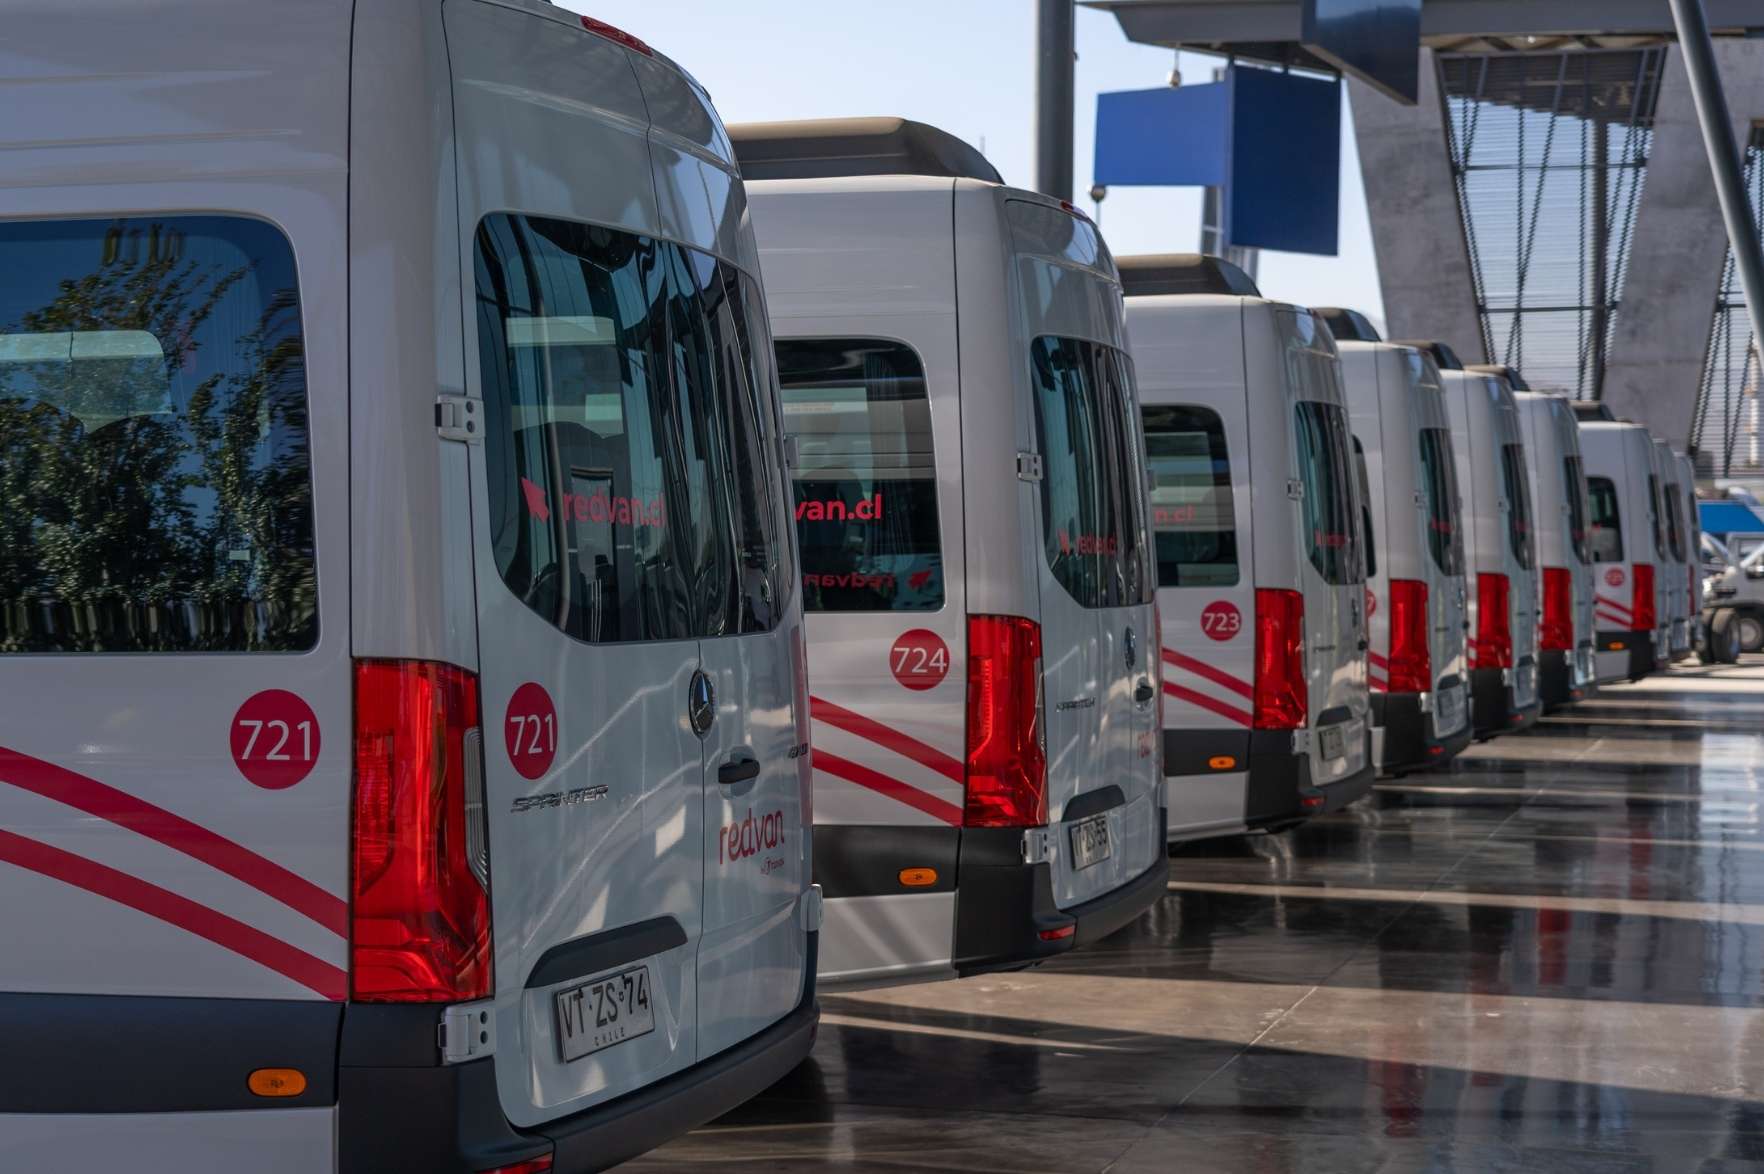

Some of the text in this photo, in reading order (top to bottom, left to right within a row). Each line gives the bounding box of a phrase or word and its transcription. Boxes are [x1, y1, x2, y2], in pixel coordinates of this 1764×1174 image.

[1203, 612, 1240, 631] 723
[893, 647, 948, 673] 724
[239, 719, 312, 761] 721
[511, 714, 555, 756] 721
[510, 784, 609, 813] SPRINTER
[719, 807, 785, 865] redvan
